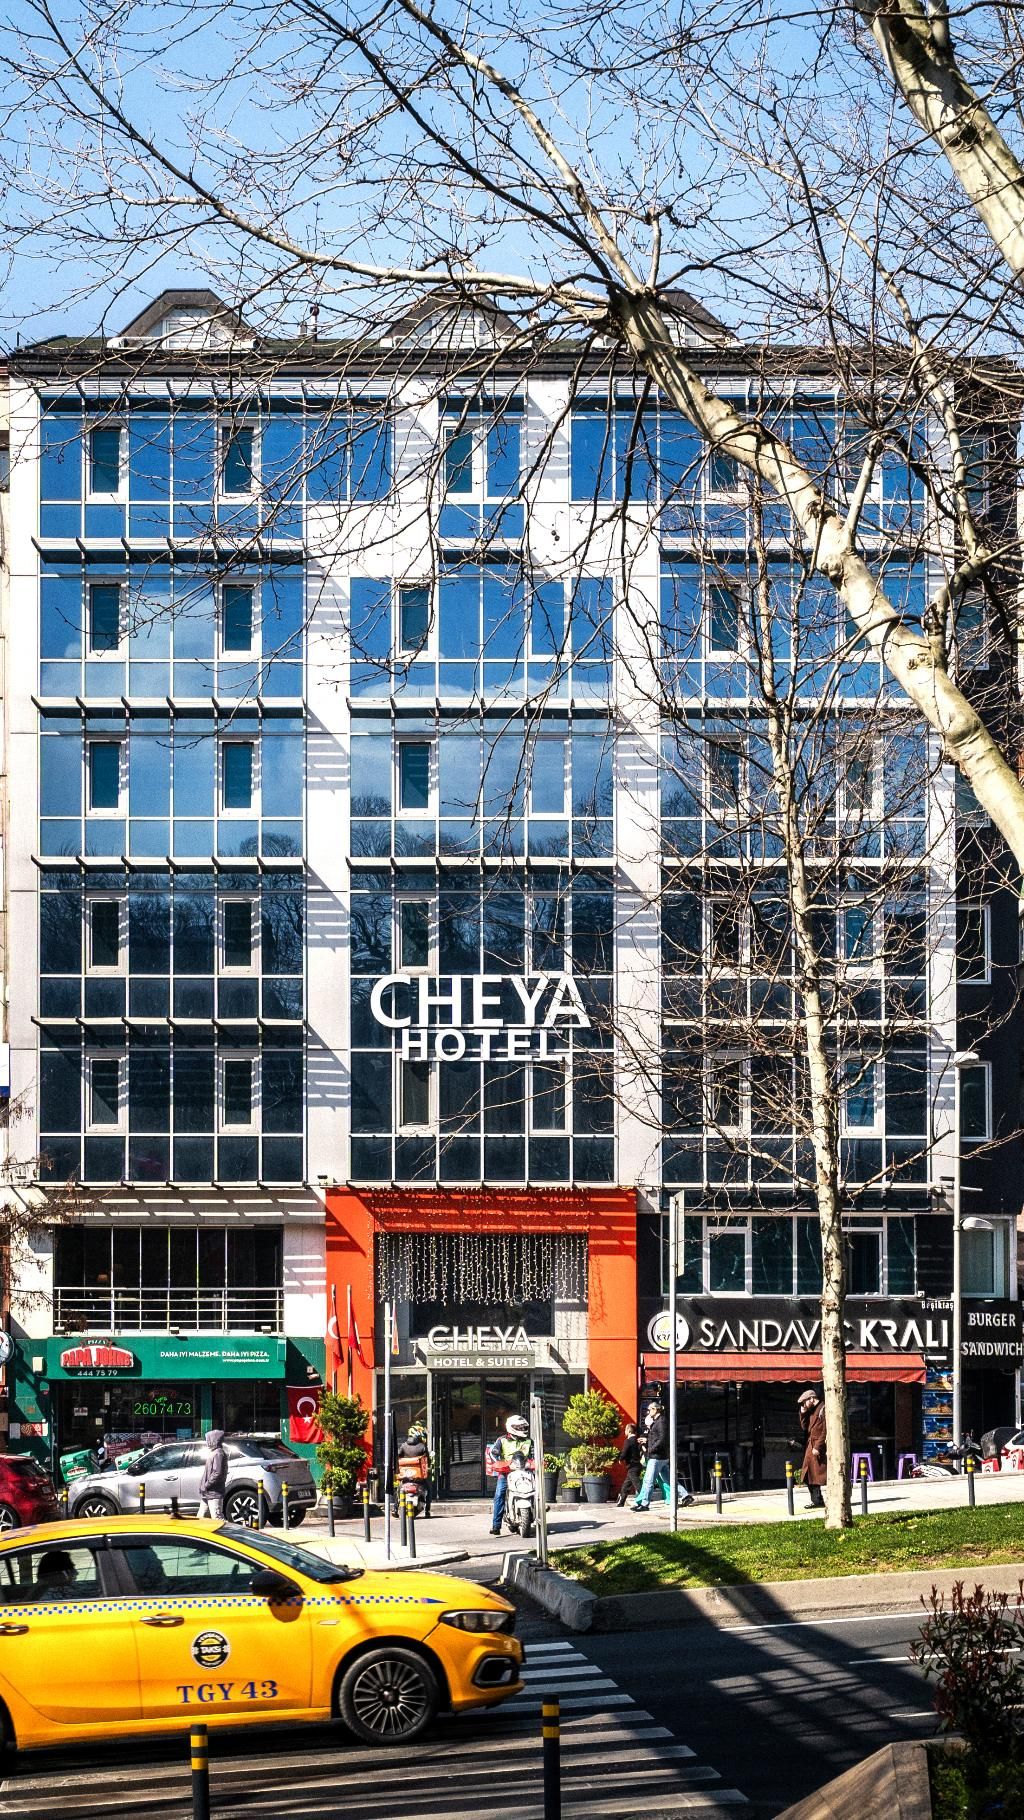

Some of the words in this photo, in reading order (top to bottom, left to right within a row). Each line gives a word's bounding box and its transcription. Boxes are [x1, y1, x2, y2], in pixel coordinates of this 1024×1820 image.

[370, 973, 591, 1028] CHEYA
[401, 1028, 563, 1062] HOTEL
[967, 1312, 1016, 1327] BURGER
[427, 1324, 533, 1351] CHEYA
[699, 1319, 851, 1347] SANDAV
[860, 1319, 949, 1347] KRALI
[62, 1348, 93, 1367] PAPA
[960, 1341, 1023, 1356] SANDWICH
[433, 1357, 473, 1367] HOTEL
[475, 1357, 486, 1367] &
[487, 1357, 529, 1367] SUITES
[175, 1682, 235, 1704] TGY
[240, 1680, 278, 1699] 43
